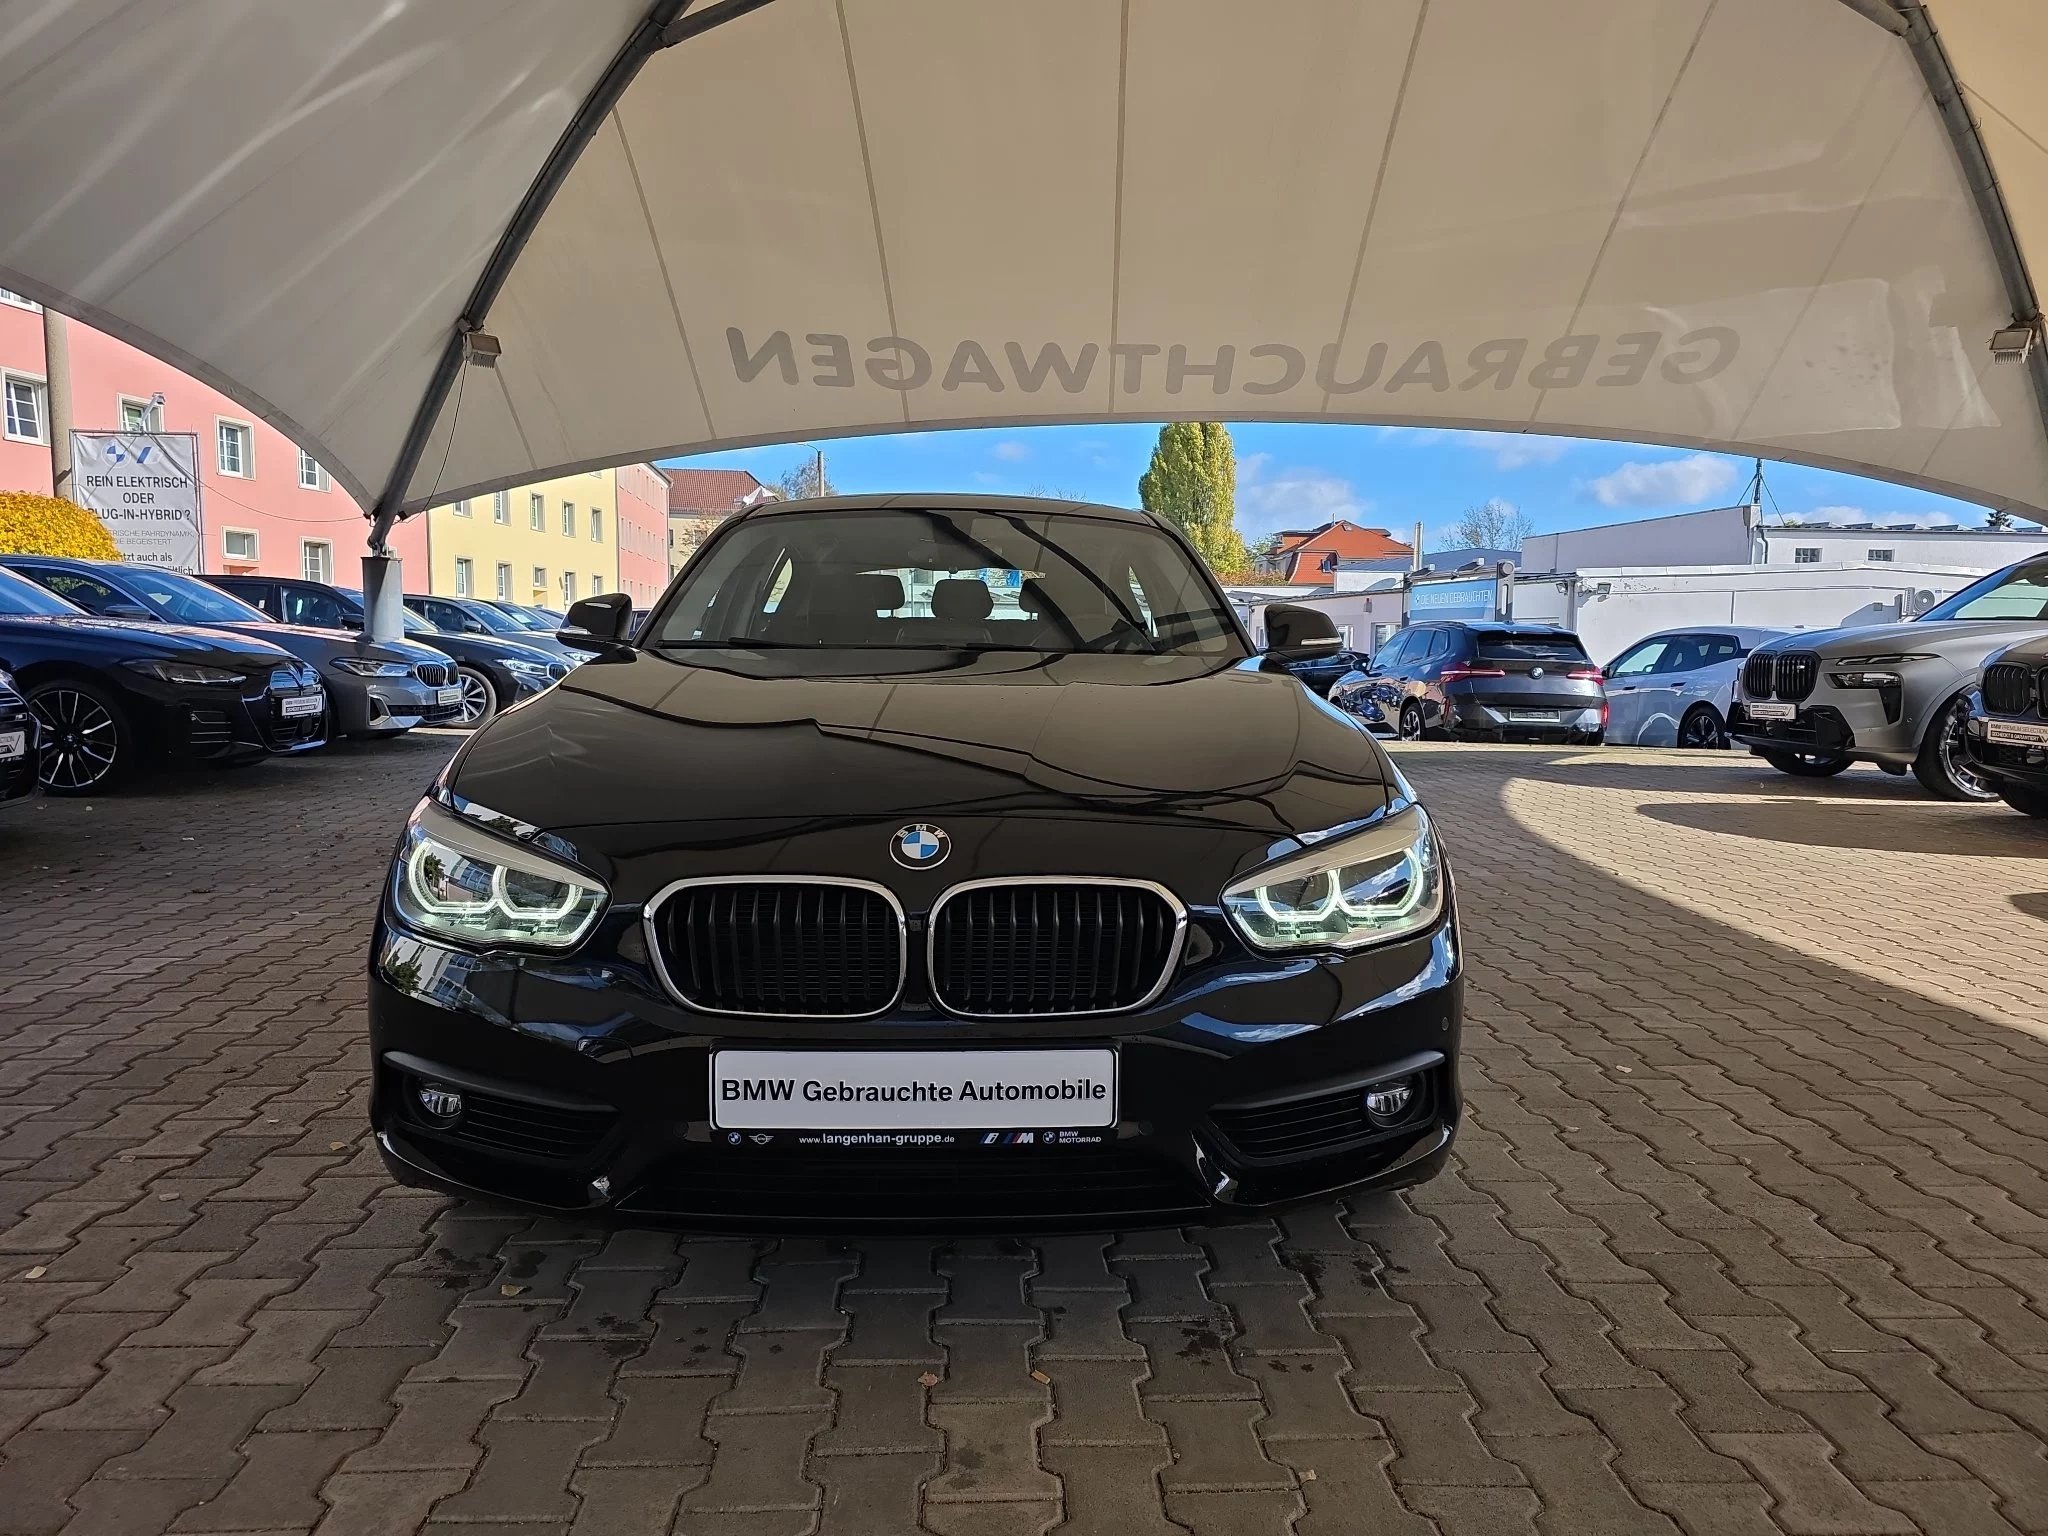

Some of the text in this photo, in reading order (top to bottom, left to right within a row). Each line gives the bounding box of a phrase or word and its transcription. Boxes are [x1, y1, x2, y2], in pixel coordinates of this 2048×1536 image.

[86, 476, 188, 488] REIN ELEKTRISCH
[123, 493, 155, 504] ODER
[120, 552, 173, 562] tzt auch als
[896, 825, 947, 838] BMW
[722, 1079, 1106, 1101] BMW Gebrauchte Automobile
[799, 1133, 954, 1145] www.langenhan-gruppe.de
